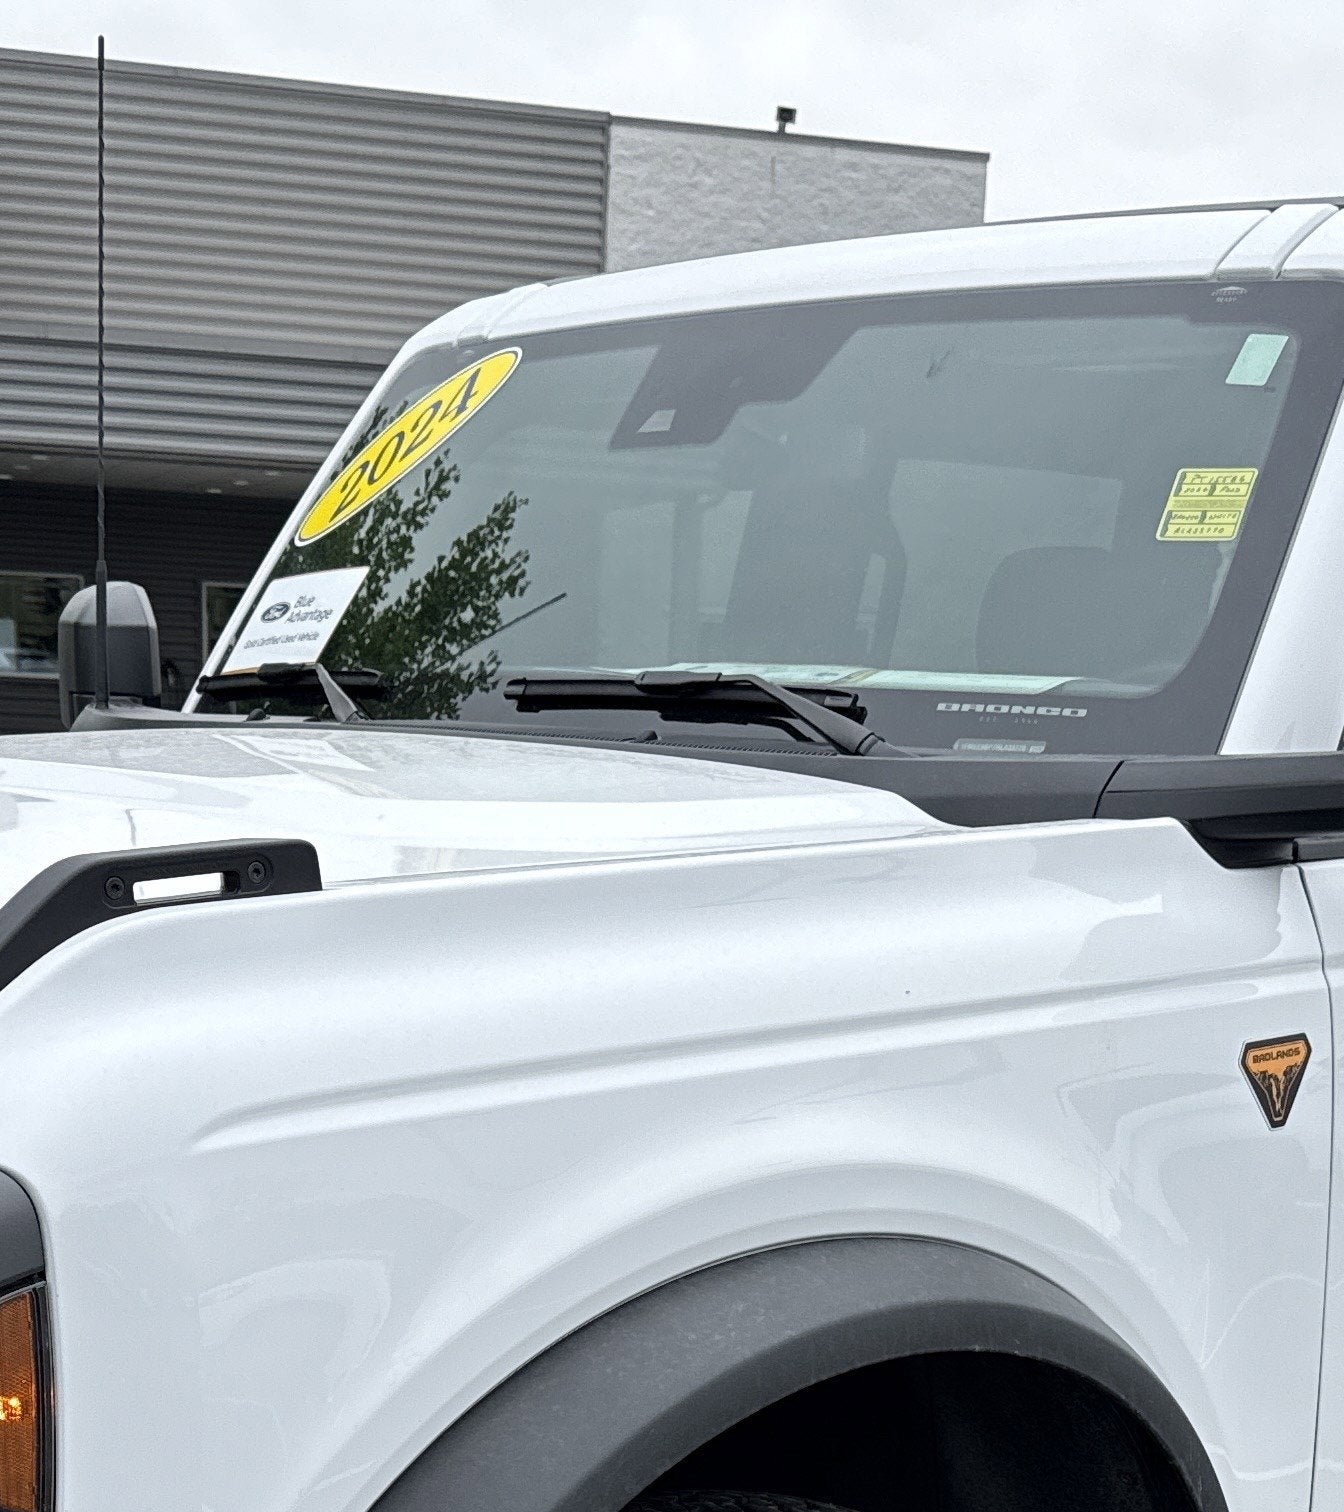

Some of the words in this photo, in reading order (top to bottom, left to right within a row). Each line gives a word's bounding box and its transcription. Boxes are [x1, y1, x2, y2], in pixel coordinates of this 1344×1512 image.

[328, 366, 482, 524] 2024
[936, 702, 1088, 718] BRONCO
[1252, 1046, 1301, 1064] BADLANDS
